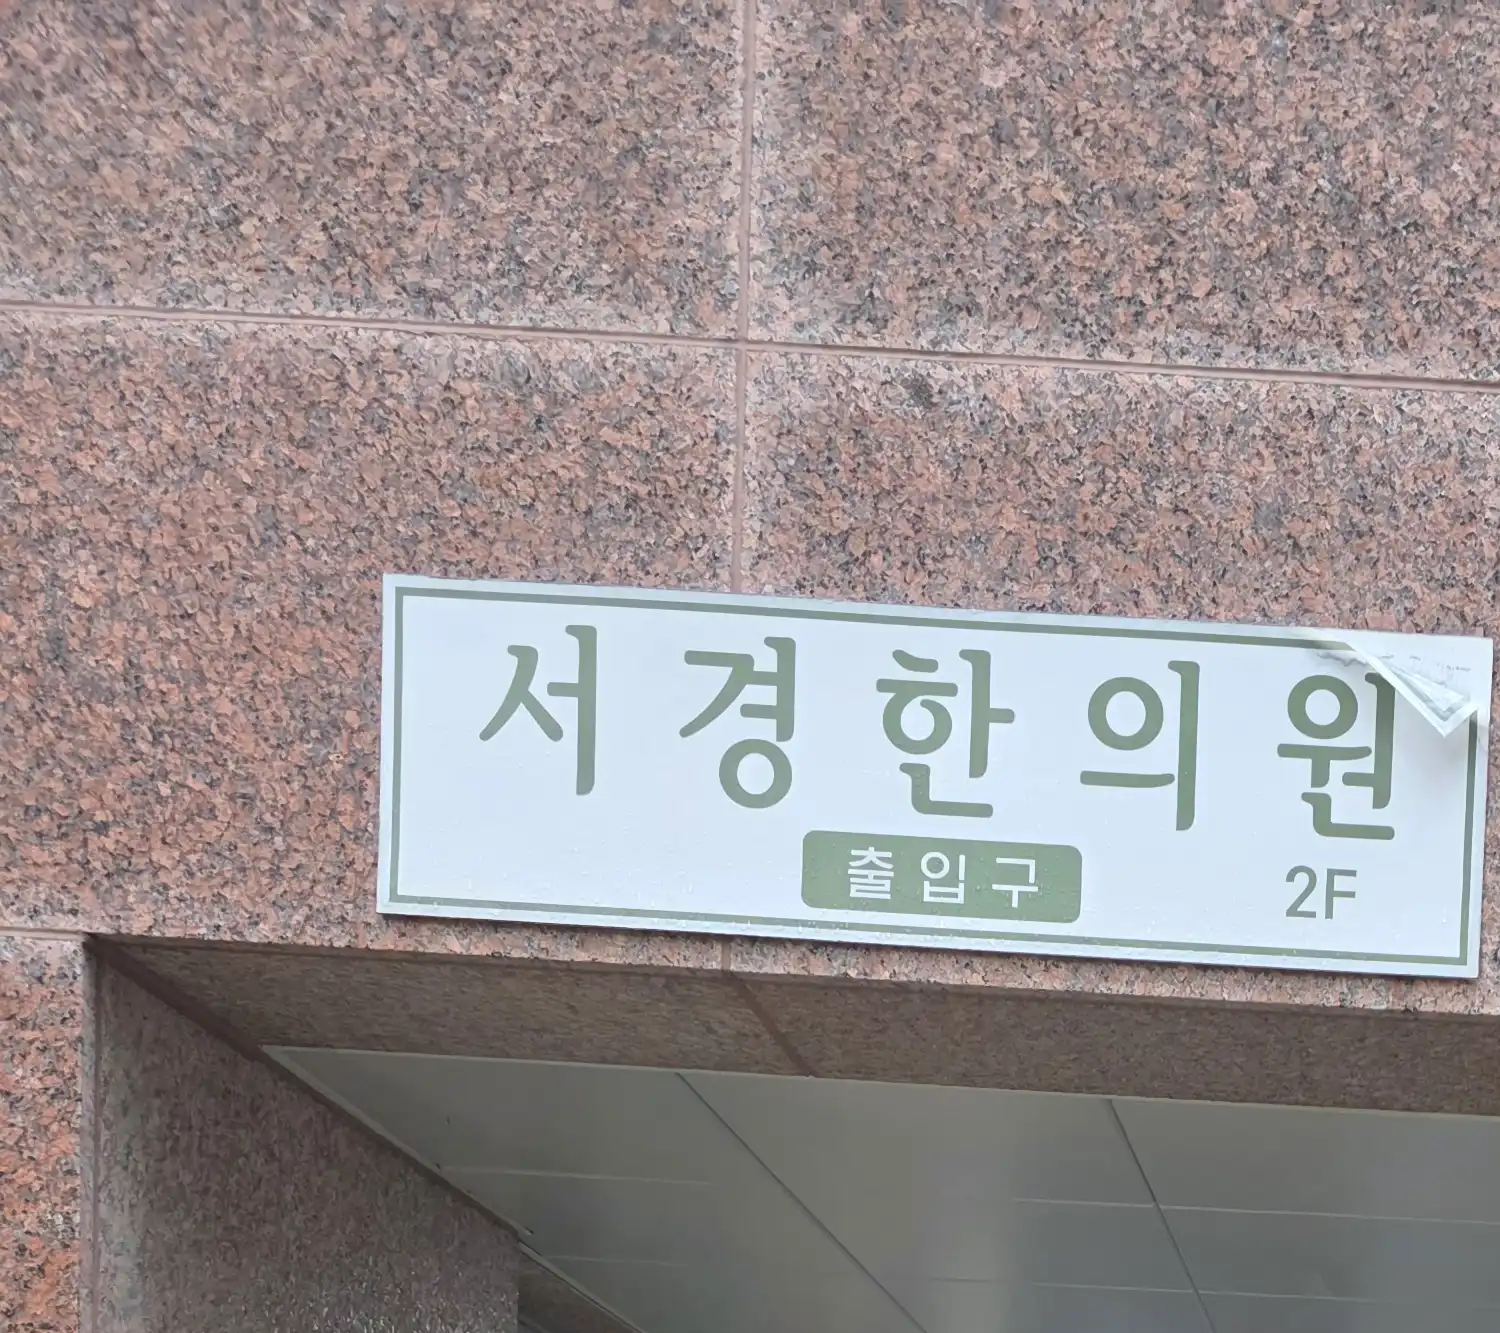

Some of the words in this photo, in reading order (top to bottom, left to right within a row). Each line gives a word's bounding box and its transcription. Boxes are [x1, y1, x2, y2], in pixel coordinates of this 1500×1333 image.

[479, 624, 1396, 842] 서경한의원
[846, 846, 1039, 906] 출입구
[1284, 865, 1358, 921] 2F
